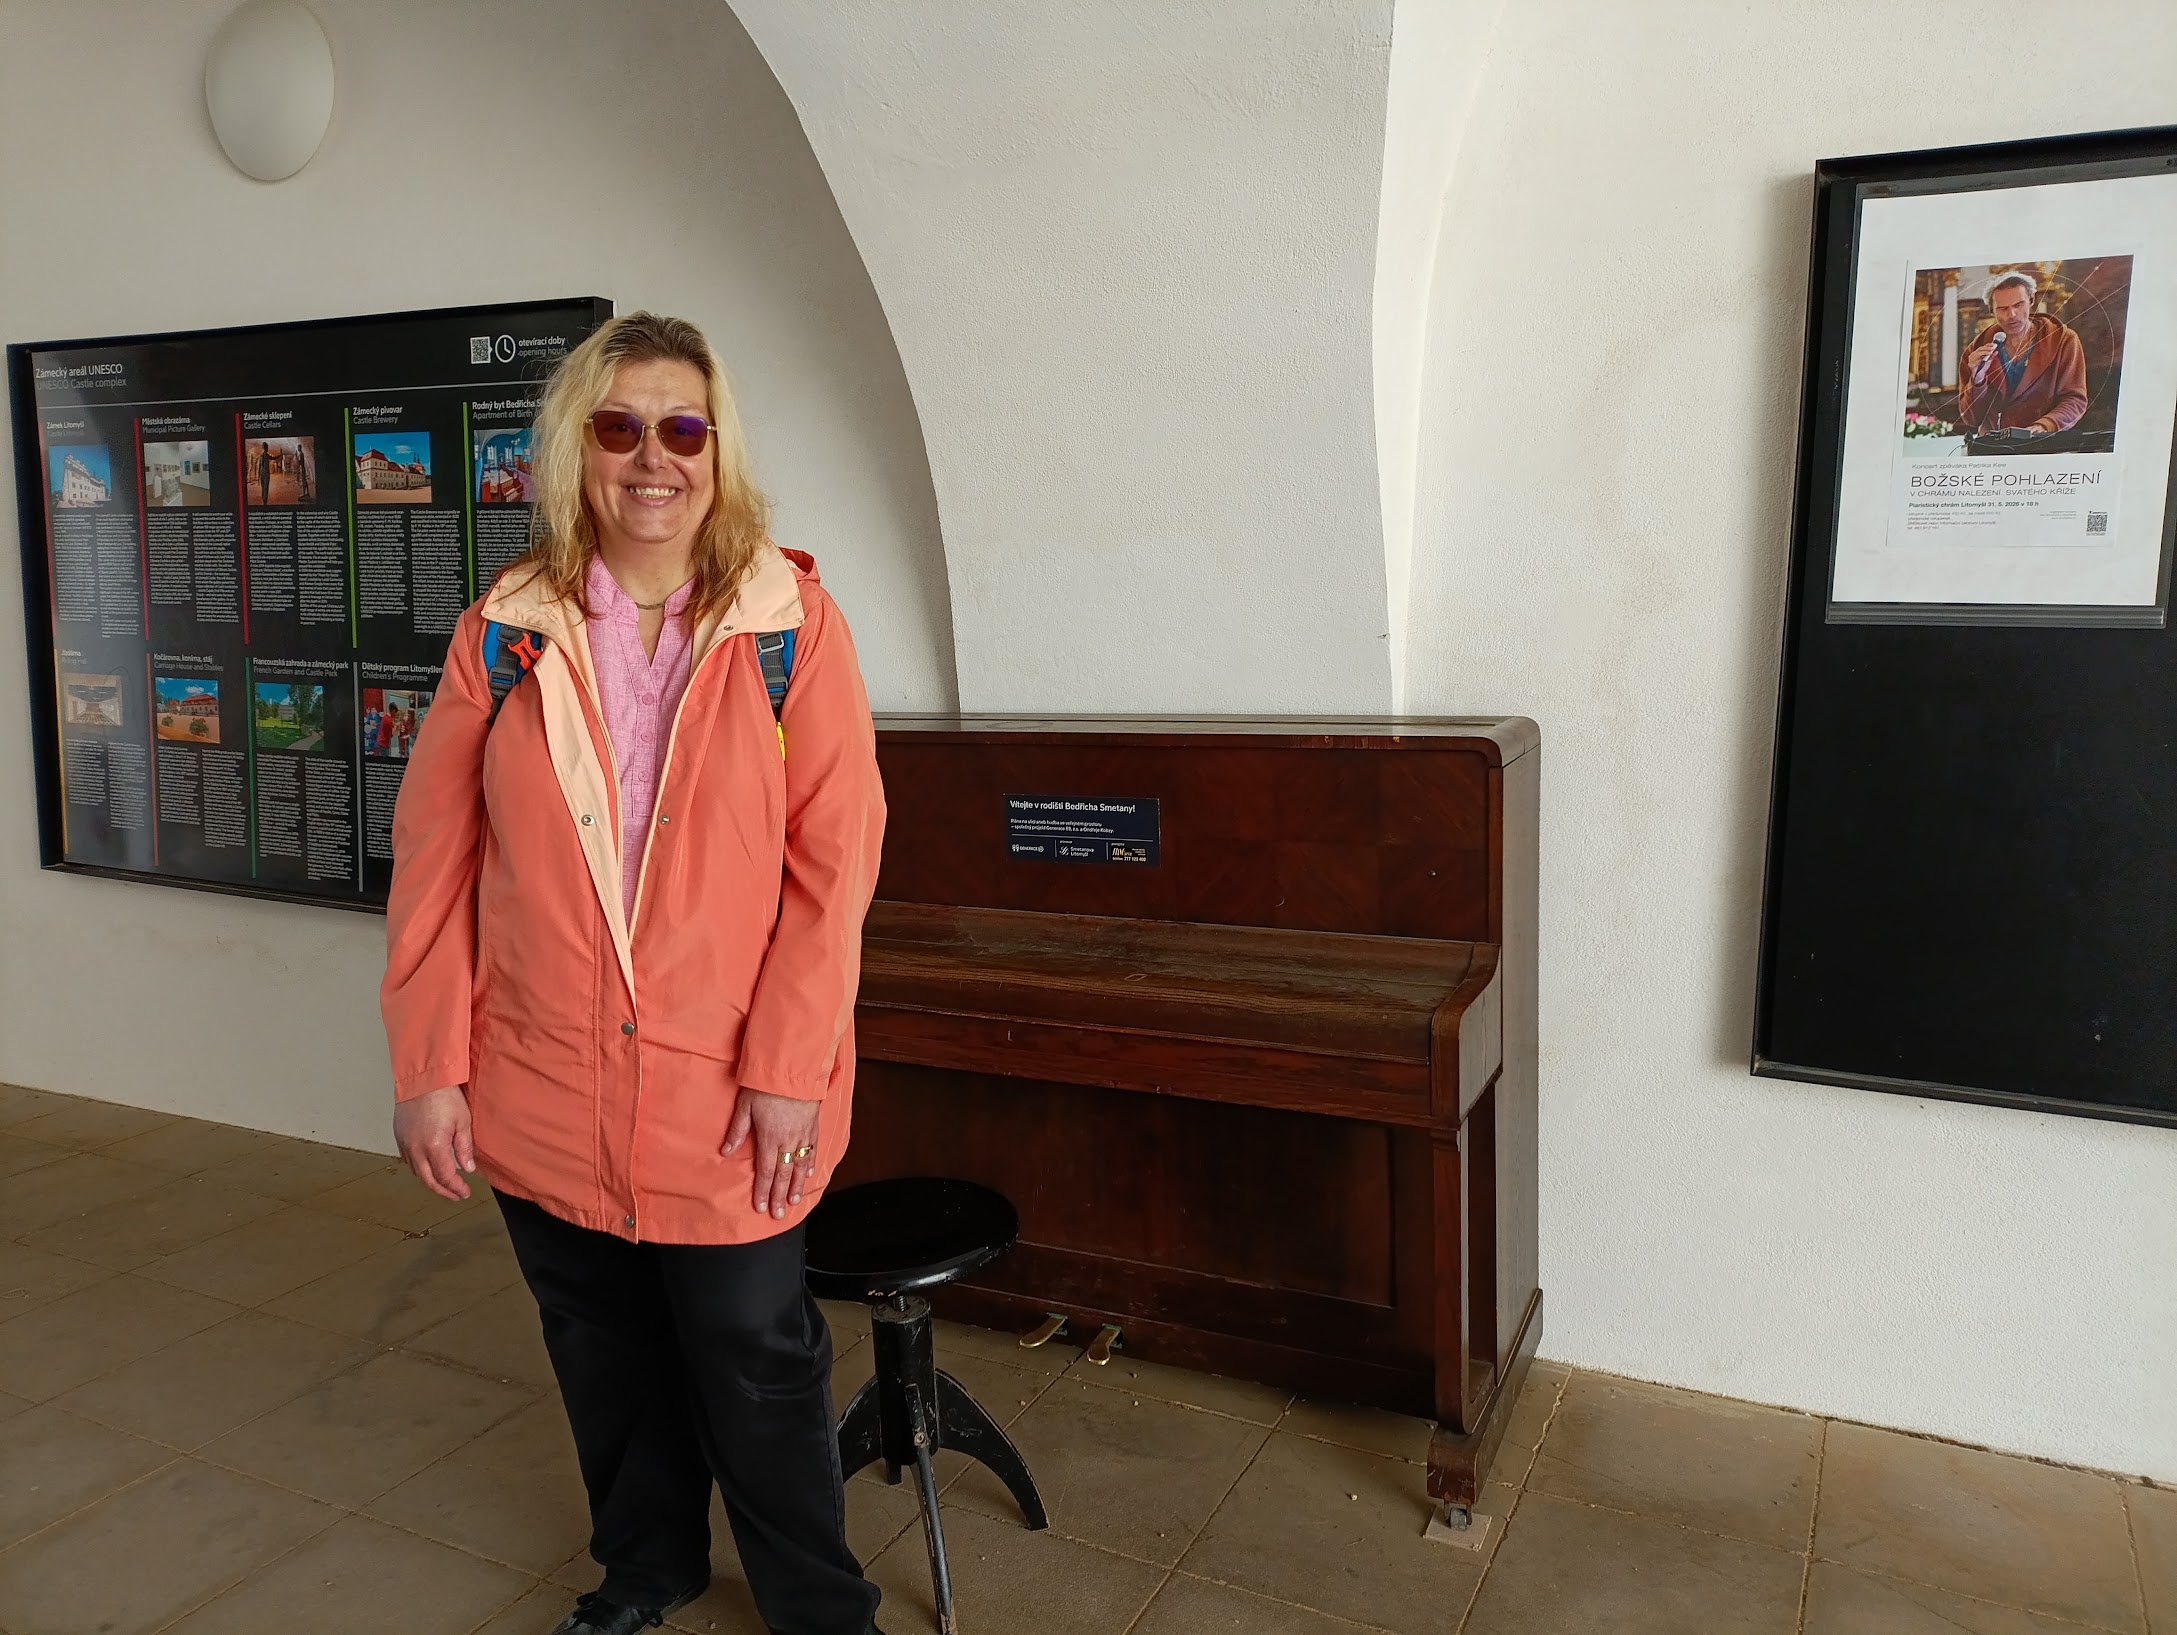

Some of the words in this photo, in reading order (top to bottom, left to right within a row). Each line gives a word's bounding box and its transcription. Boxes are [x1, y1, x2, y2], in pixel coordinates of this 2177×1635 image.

[518, 337, 548, 347] otevírací
[548, 335, 566, 346] doby
[519, 347, 547, 358] opening
[548, 346, 567, 355] hours
[36, 367, 67, 379] Zámecký
[69, 367, 87, 377] areál
[88, 363, 123, 375] UNESCO
[71, 379, 94, 389] Castle
[95, 376, 127, 389] complex
[353, 406, 379, 416] Zámecký
[380, 405, 403, 416] pivovar
[472, 401, 493, 411] Rodný
[494, 400, 505, 410] byt
[506, 399, 535, 409] Bedřicha
[353, 416, 372, 424] Castle
[373, 415, 398, 424] Brewery
[473, 410, 507, 421] Apartment
[508, 409, 516, 418] of
[517, 409, 533, 418] Birth
[244, 421, 261, 429] Castle
[262, 420, 281, 429] Cellars
[1911, 472, 1984, 488] BOŽSKÉ
[1991, 469, 2102, 487] POHLAZENÍ
[1958, 488, 2001, 496] NALEZENÍ
[2005, 488, 2047, 496] SVATÉHO
[2049, 487, 2077, 495] KŘÍŽE
[193, 663, 203, 671] and
[254, 665, 273, 674] French
[273, 666, 293, 675] Garden
[294, 667, 305, 676] and
[306, 668, 324, 676] Castle
[325, 669, 338, 677] Park
[336, 661, 349, 670] park
[361, 662, 383, 672] Dětský
[383, 664, 410, 673] program
[362, 671, 392, 680] Children's
[392, 673, 428, 682] Programme
[1040, 801, 1064, 810] rodišti
[1064, 802, 1099, 812] Bedřicha
[1099, 803, 1136, 815] Smetany!
